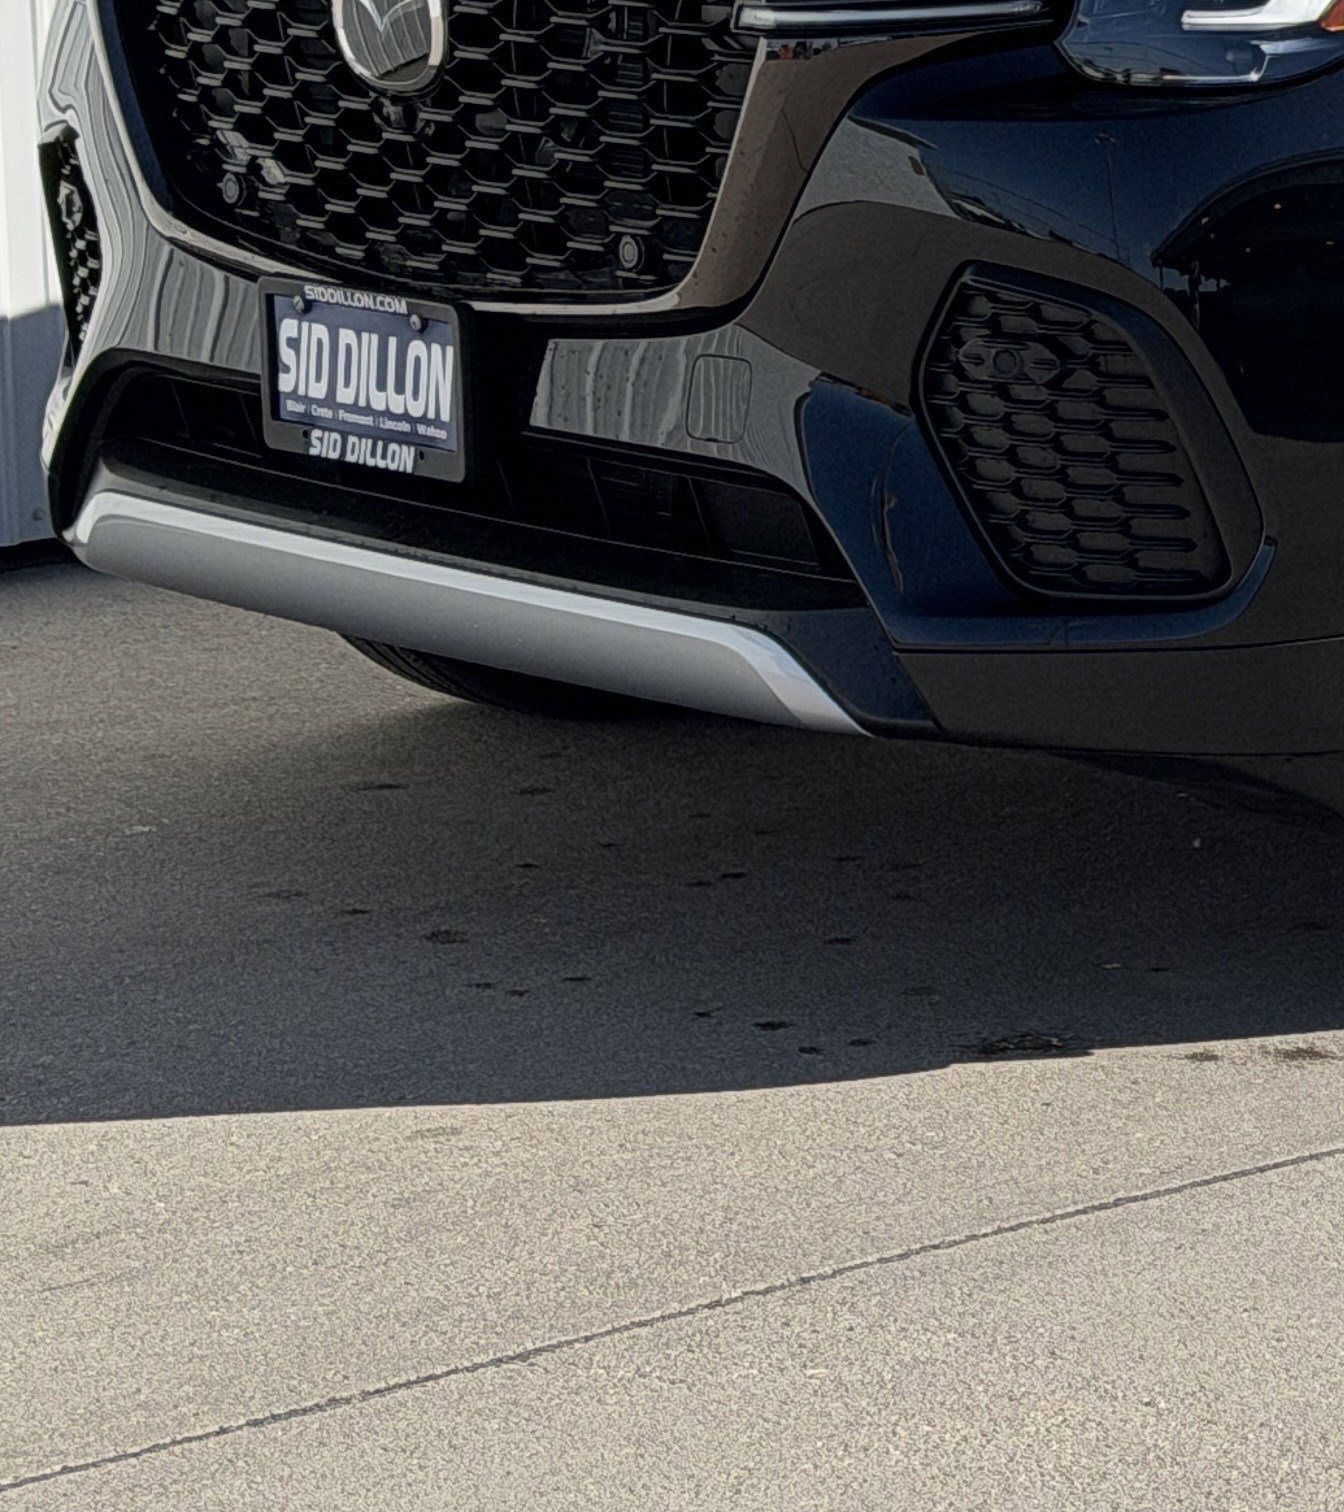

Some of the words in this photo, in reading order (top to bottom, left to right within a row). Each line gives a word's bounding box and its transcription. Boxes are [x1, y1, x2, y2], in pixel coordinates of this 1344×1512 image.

[303, 285, 408, 314] SIDDILLON.COM
[278, 318, 330, 399] SID
[336, 329, 454, 422] DILLON
[309, 428, 341, 459] SID
[344, 434, 416, 474] DILLON
